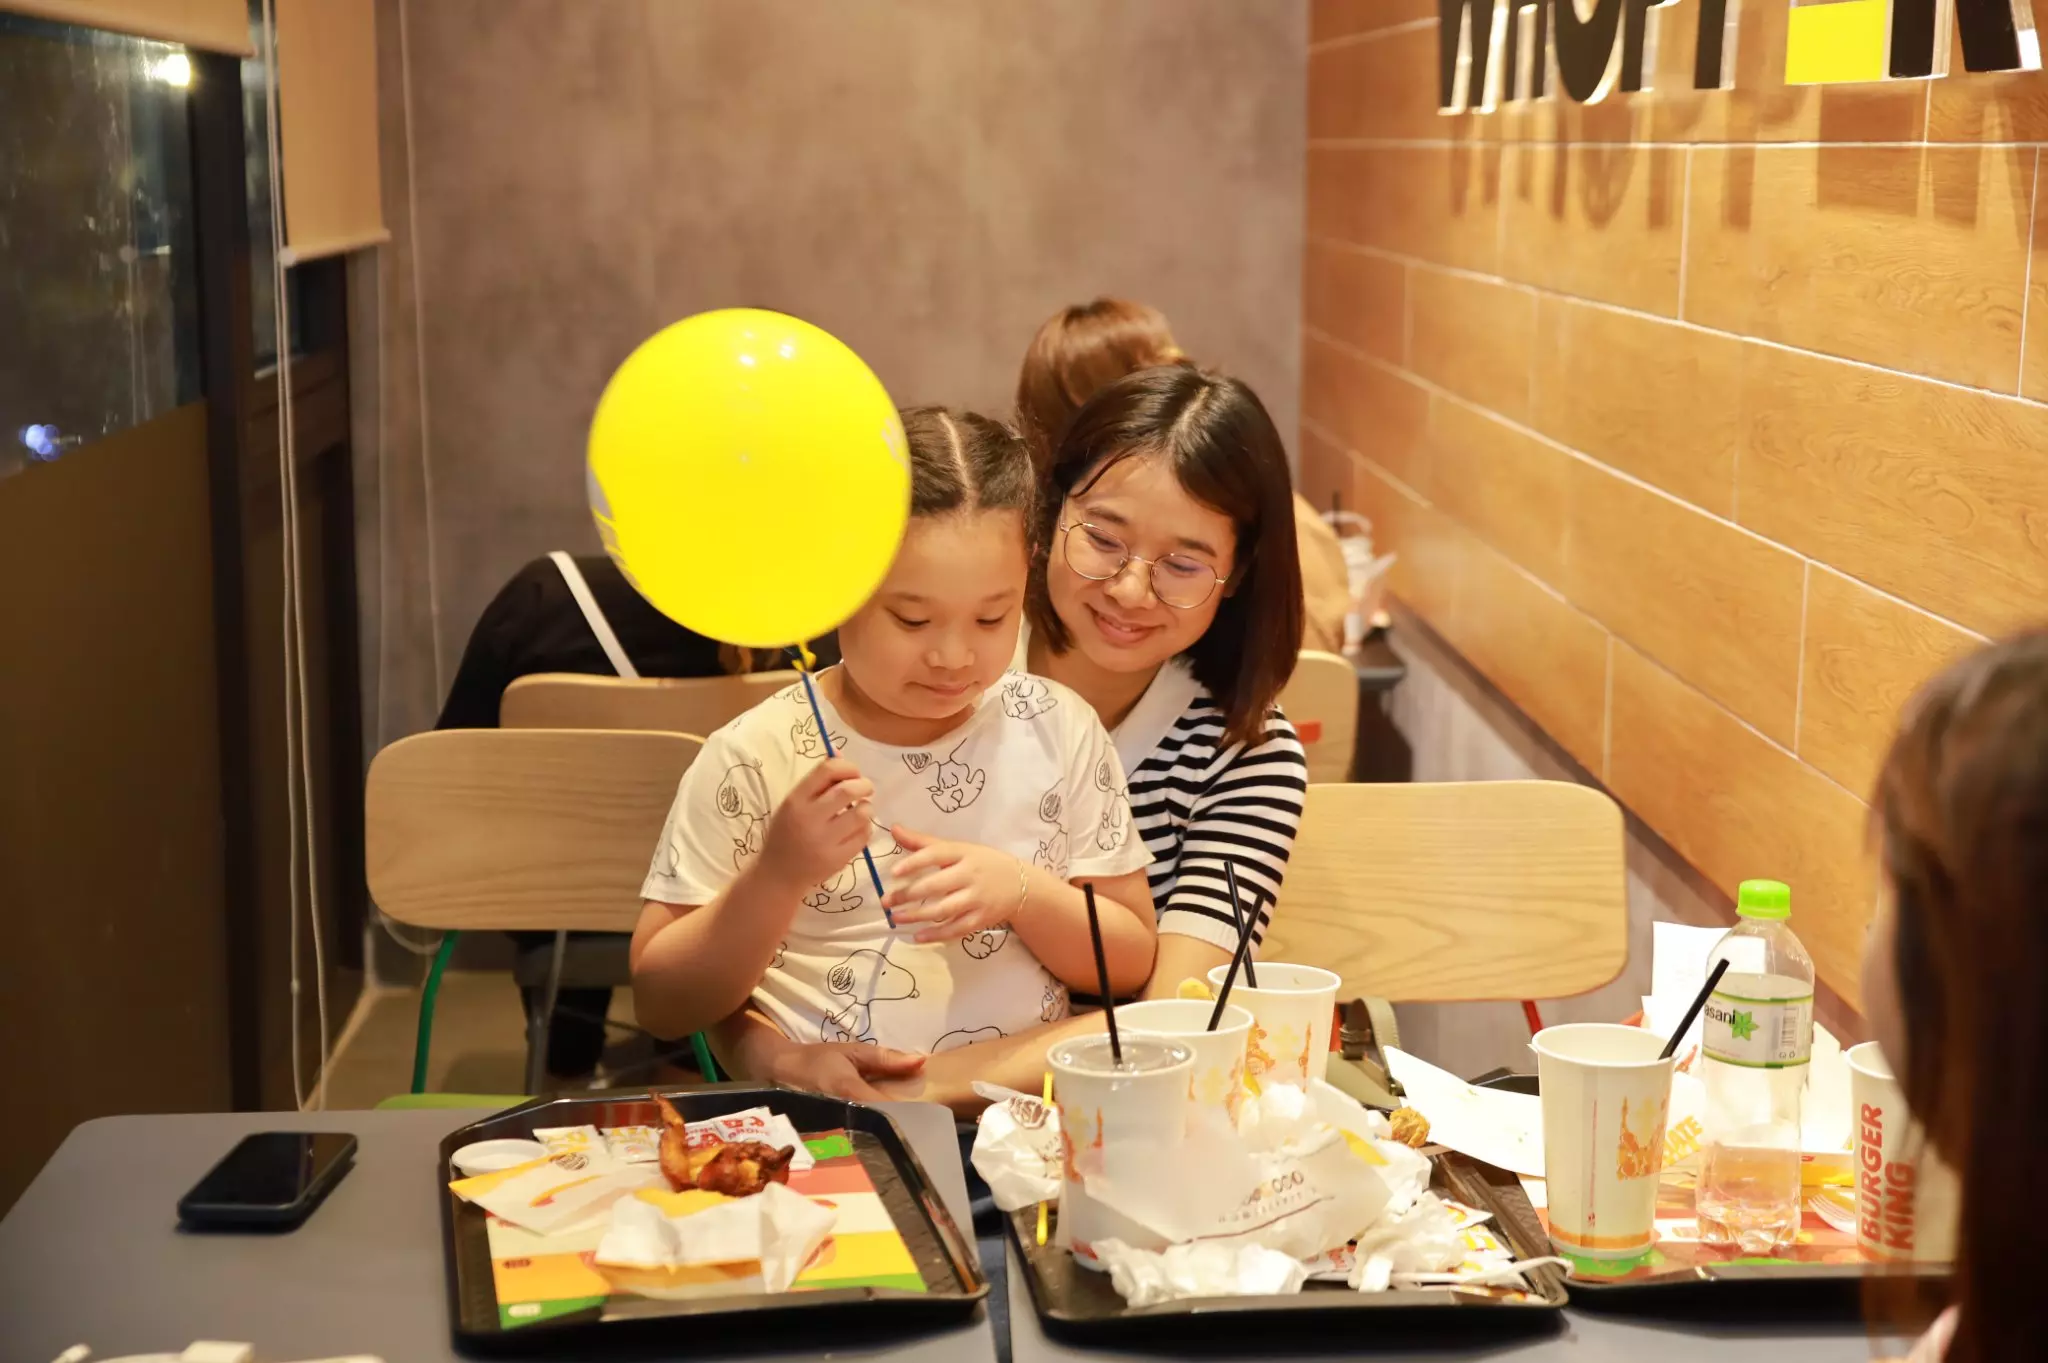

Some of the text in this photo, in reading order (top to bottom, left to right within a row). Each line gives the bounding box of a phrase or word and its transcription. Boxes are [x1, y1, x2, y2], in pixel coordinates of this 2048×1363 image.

[1703, 1003, 1737, 1025] asani
[1860, 1103, 1883, 1244] BURGER
[1884, 1161, 1915, 1251] KING
